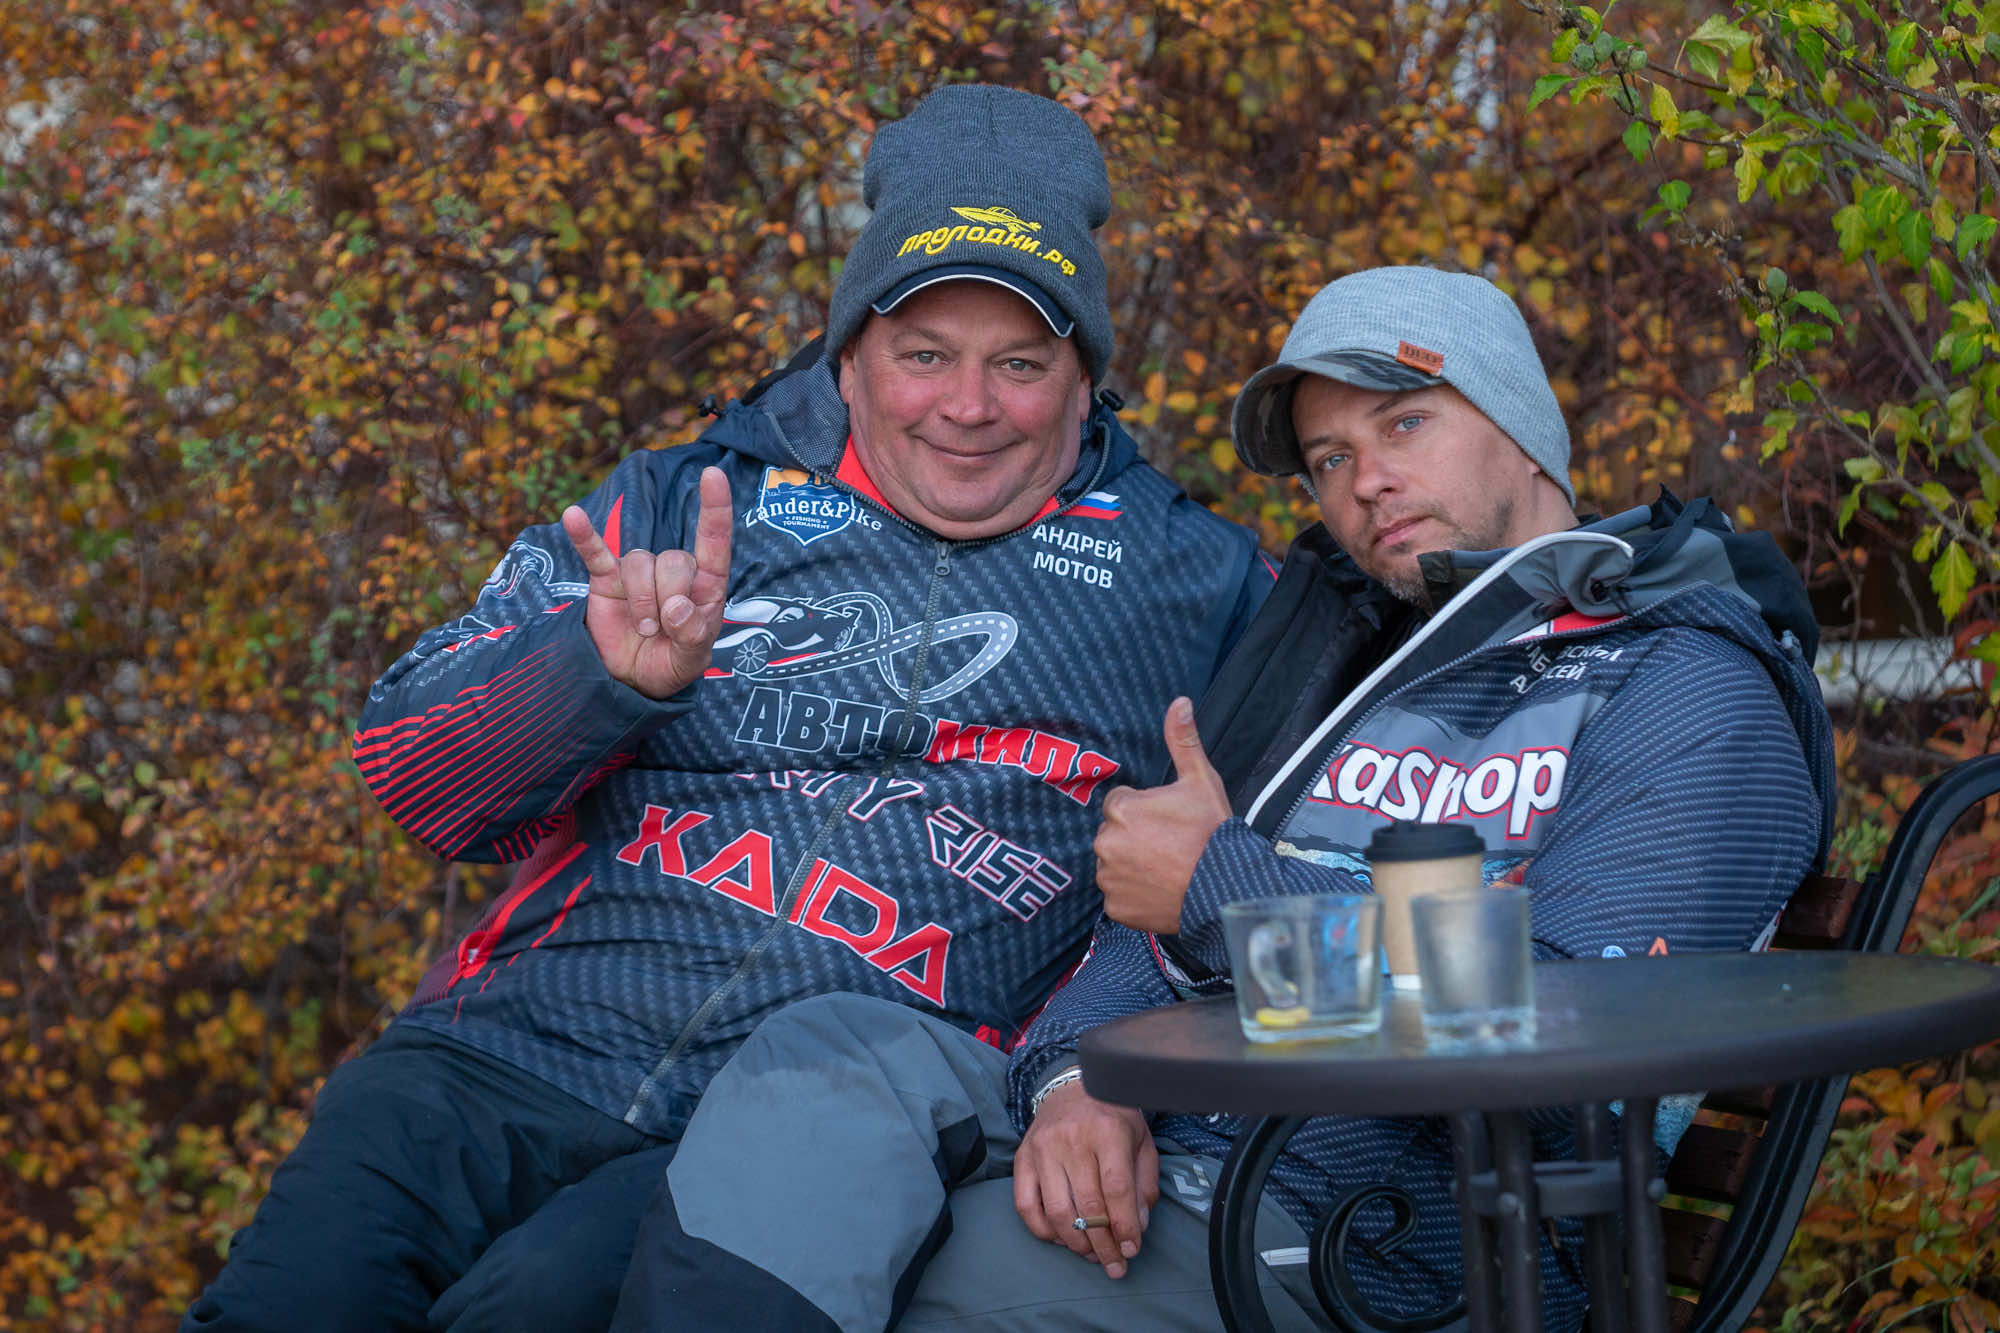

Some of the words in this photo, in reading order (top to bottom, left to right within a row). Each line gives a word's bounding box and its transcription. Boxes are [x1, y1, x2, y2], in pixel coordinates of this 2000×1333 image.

[783, 520, 830, 530] TOURNAMENT
[1031, 524, 1123, 564] АНДРЕЙ
[1033, 551, 1113, 589] МОТОВ
[734, 686, 1120, 806] АВТОМИЛЯ
[926, 804, 1073, 923] RISE
[616, 803, 953, 1009] KAIDA
